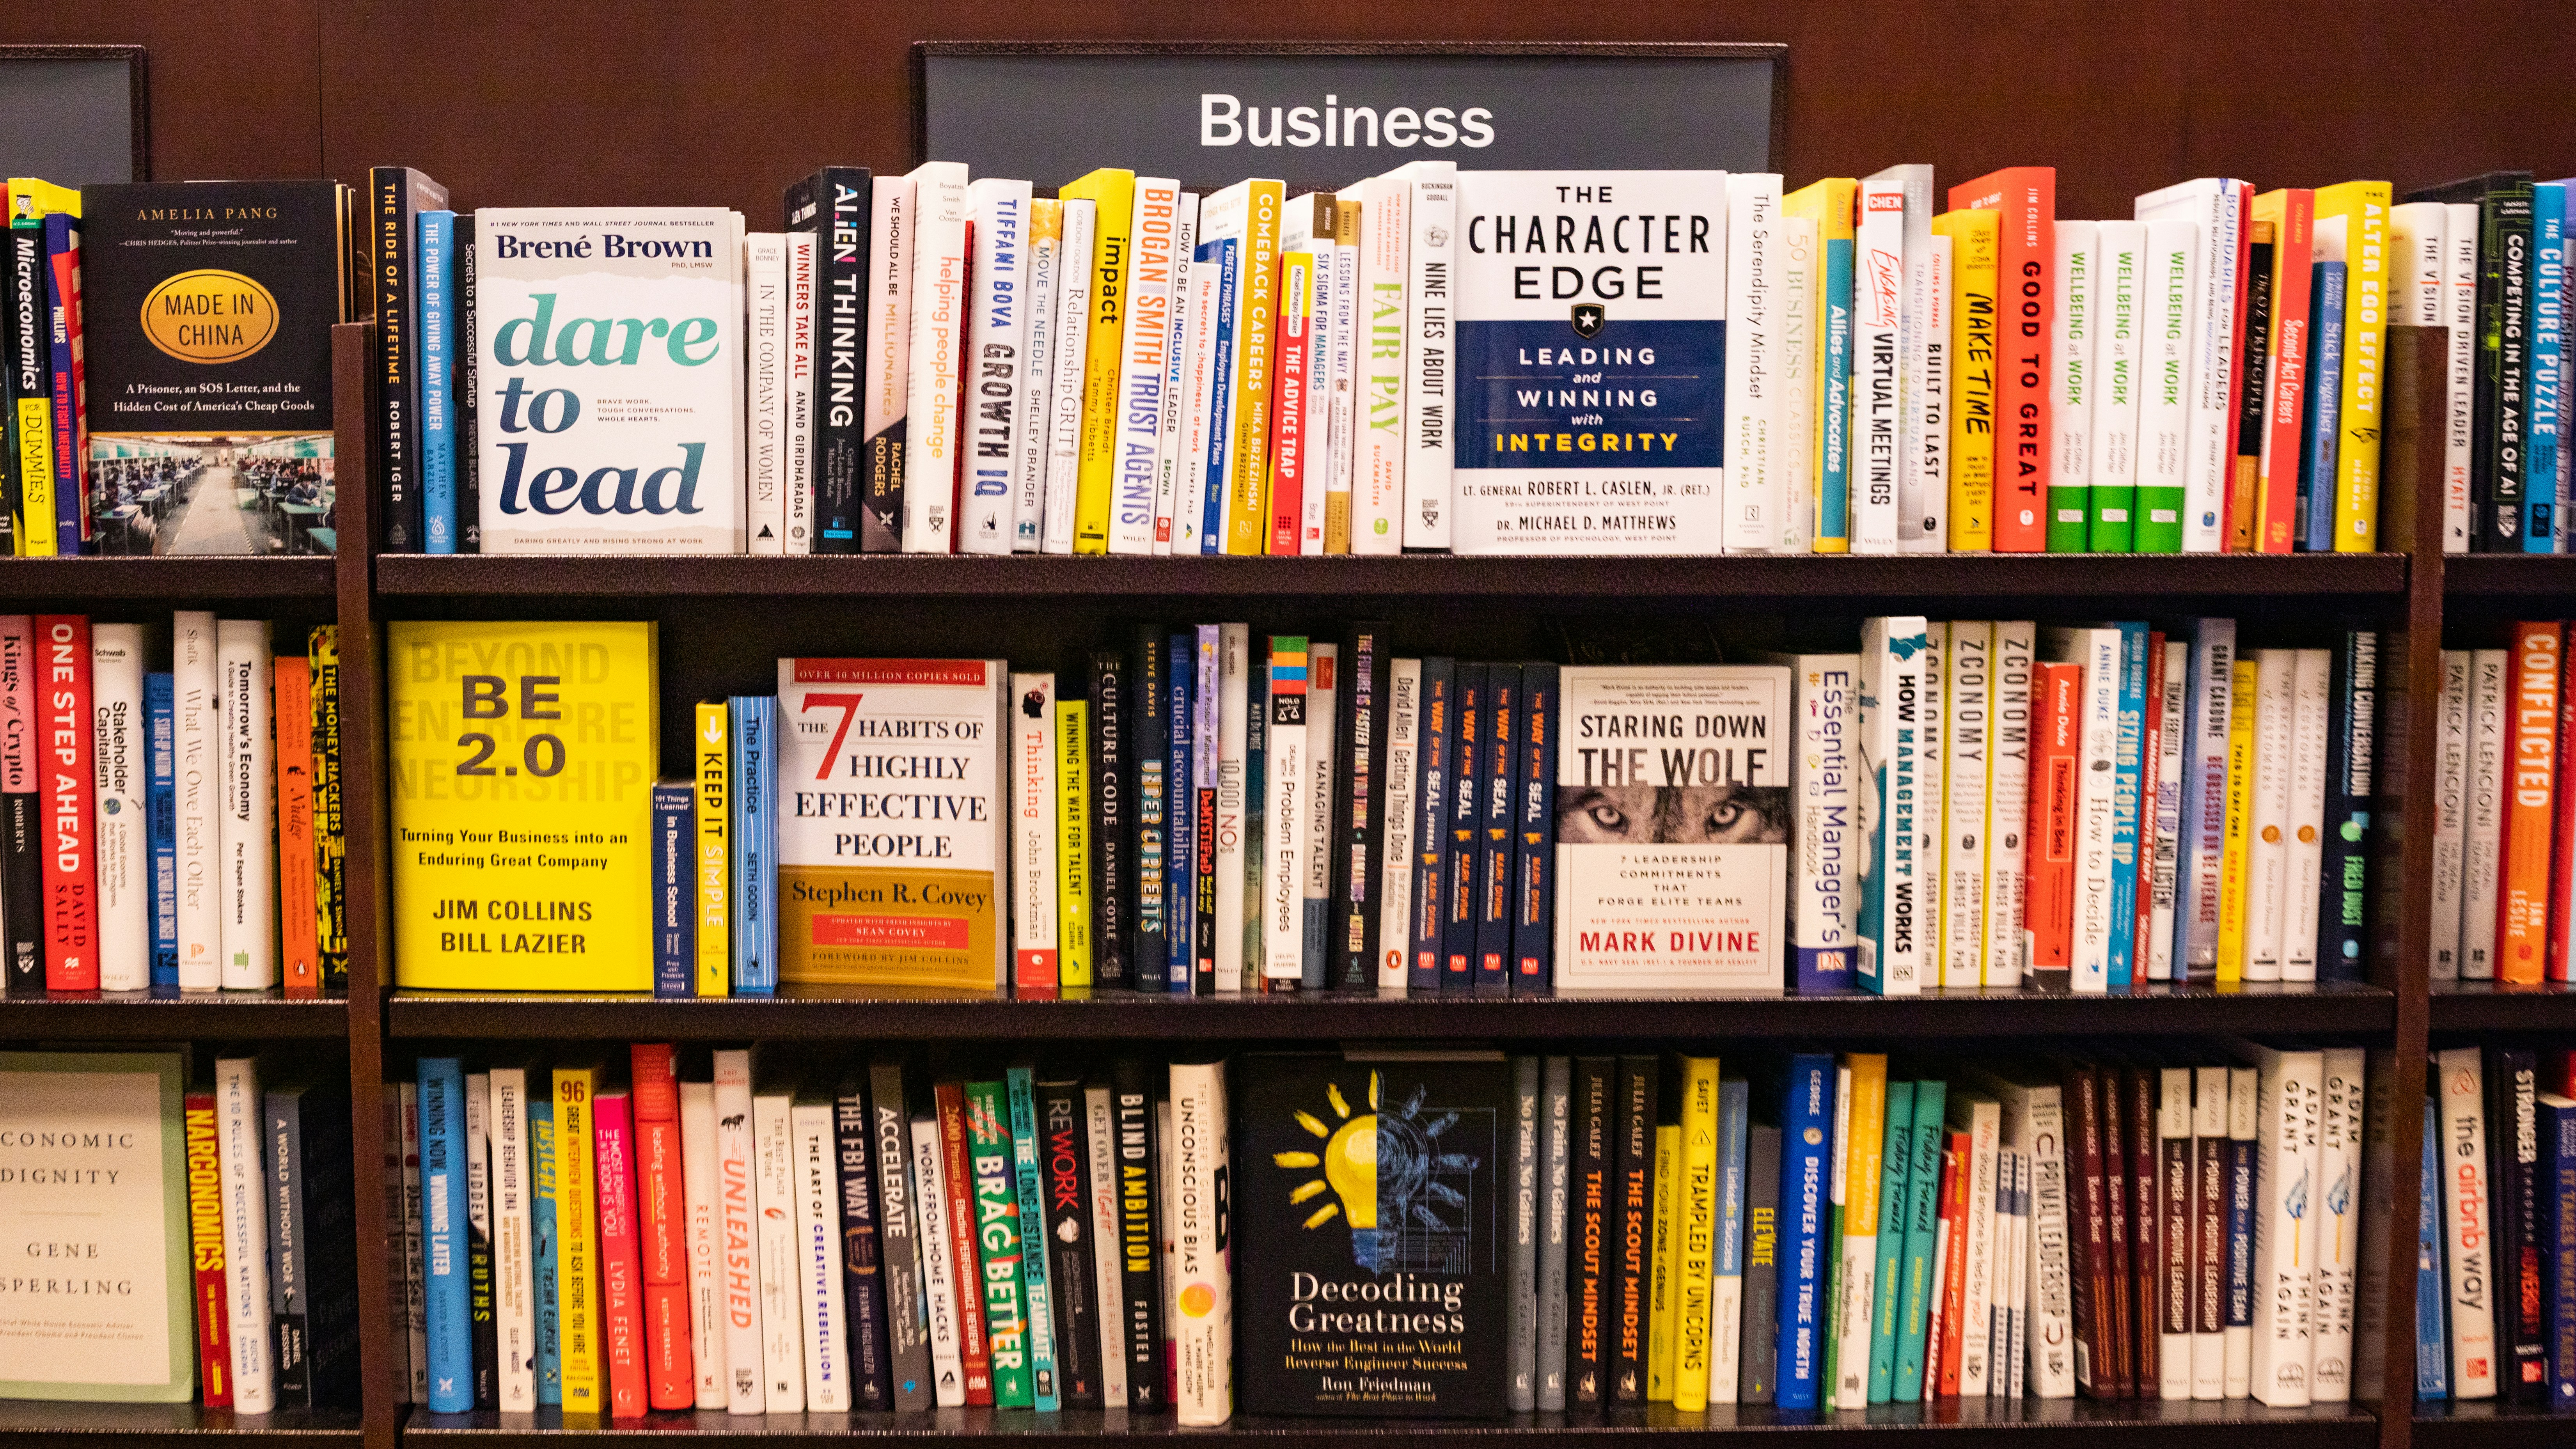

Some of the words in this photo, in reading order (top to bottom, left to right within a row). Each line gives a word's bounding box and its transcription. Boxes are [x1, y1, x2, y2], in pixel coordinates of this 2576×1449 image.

[1201, 93, 1495, 148] Business
[137, 208, 215, 220] AMELIA
[226, 208, 278, 219] PANG
[385, 183, 396, 214] THE
[1556, 187, 1613, 203] THE
[385, 222, 396, 259] RIDE
[498, 235, 592, 259] Brené
[603, 235, 712, 259] Brown
[994, 200, 1017, 271] TIFFANI
[1141, 189, 1174, 281] BROGAN
[1251, 194, 1272, 301] COMEBACK
[1469, 216, 1710, 254] CHARACTER
[2362, 203, 2381, 272] ALTER
[386, 265, 397, 286] OF
[387, 293, 396, 303] A
[796, 244, 809, 310] WINNERS
[933, 257, 961, 323] helping
[1100, 237, 1127, 325] impact
[1424, 262, 1447, 298] NINE
[1515, 266, 1663, 299] EDGE
[2022, 261, 2041, 339] GOOD
[16, 238, 40, 391] Microeconomics
[165, 294, 223, 316] MADE
[234, 294, 253, 314] IN
[991, 277, 1013, 328] BOVA
[1424, 308, 1445, 339] LIES
[2361, 281, 2379, 324] EGO
[179, 324, 243, 346] CHINA
[387, 309, 399, 383] LIFETIME
[494, 293, 720, 367] dare
[795, 316, 808, 349] TAKE
[830, 273, 858, 428] THINKING
[1133, 296, 1165, 365] SMITH
[1248, 307, 1267, 391] CAREERS
[795, 354, 807, 379] ALL
[935, 326, 955, 390] people
[1285, 345, 1301, 374] THE
[1422, 348, 1445, 397] ABOUT
[1520, 349, 1655, 365] LEADING
[1573, 372, 1602, 383] and
[1873, 333, 1894, 415] VIRTUAL
[2022, 355, 2040, 388] TO
[2357, 332, 2377, 412] EFFECT
[25, 404, 41, 412] FOR
[114, 401, 151, 412] Hidden
[154, 402, 177, 411] Cost
[180, 401, 191, 411] of
[193, 401, 242, 411] America's
[245, 401, 278, 413] Cheap
[281, 401, 314, 411] Goods
[126, 385, 135, 393] A
[137, 383, 182, 394] Prisoner,
[199, 383, 223, 393] SOS
[226, 383, 260, 394] Letter,
[263, 383, 281, 393] and
[284, 383, 300, 393] the
[495, 378, 580, 433] to
[976, 343, 1016, 458] GROWTH
[1127, 374, 1160, 435] TRUST
[1282, 378, 1299, 434] ADVICE
[1517, 390, 1657, 406] WINNING
[390, 401, 400, 459] ROBERT
[926, 393, 954, 459] change
[1421, 406, 1442, 449] WORK
[1497, 433, 1678, 451] INTEGRITY
[1572, 413, 1603, 426] with
[25, 415, 44, 504] DUMMIES
[1280, 438, 1297, 479] TRAP
[1870, 417, 1891, 505] MEETINGS
[2018, 403, 2038, 495] GREAT
[392, 467, 401, 501] IGER
[497, 442, 706, 515] lead
[974, 469, 1008, 496] IQ
[1121, 443, 1153, 525] AGENTS
[1464, 486, 1476, 496] LT.
[1480, 485, 1522, 496] GENERAL
[1528, 481, 1581, 496] ROBERT
[1586, 481, 1597, 495] L.
[1602, 481, 1656, 497] CASLEN,
[1680, 484, 1710, 496] (RET.)
[51, 624, 74, 683] ONE
[462, 675, 561, 719] BE
[1102, 673, 1116, 763] CULTURE
[1899, 675, 1915, 722] HOW
[2518, 633, 2556, 807] CONFLICTED
[54, 691, 76, 766] STEP
[98, 707, 110, 788] Capitalism
[113, 701, 128, 795] Stakeholder
[798, 722, 828, 733] THE
[801, 693, 863, 779] 7
[860, 720, 949, 737] HABITS
[955, 722, 983, 740] OF
[1580, 716, 1683, 739] STARING
[1696, 716, 1766, 739] DOWN
[1824, 670, 1848, 796] Essential
[456, 733, 566, 777] 2.0
[850, 756, 970, 779] HIGHLY
[1024, 731, 1042, 820] Thinking
[1579, 748, 1647, 787] THE
[1661, 748, 1767, 787] WOLF
[704, 753, 722, 808] KEEP
[1103, 772, 1117, 826] CODE
[1896, 729, 1914, 876] MANAGEMENT
[56, 774, 79, 873] AHEAD
[705, 818, 723, 837] IT
[795, 793, 987, 821] EFFECTIVE
[401, 828, 453, 844] Turning
[459, 830, 493, 843] Your
[499, 830, 568, 844] Business
[575, 831, 603, 844] into
[610, 834, 627, 844] an
[835, 834, 952, 858] PEOPLE
[419, 853, 484, 869] Enduring
[490, 855, 532, 867] Great
[538, 855, 607, 870] Company
[704, 845, 724, 928] SIMPLE
[1816, 805, 1847, 942] Manager's
[433, 900, 477, 920] JIM
[488, 901, 593, 921] COLLINS
[793, 881, 887, 907] Stephen
[893, 884, 917, 903] R.
[923, 885, 986, 912] Covey
[1895, 882, 1912, 953] WORKS
[441, 933, 491, 952] BILL
[502, 933, 585, 954] LAZIER
[1580, 932, 1655, 952] MARK
[1670, 932, 1759, 952] DIVINE
[1121, 1094, 1145, 1159] BLIND
[2456, 1115, 2477, 1157] the
[879, 1107, 906, 1238] ACCELERATE
[1049, 1099, 1079, 1210] REWORK
[1181, 1098, 1198, 1229] UNCONSCIOUS
[186, 1110, 223, 1272] NARCONOMICS
[976, 1155, 1011, 1252] BRAG
[1586, 1171, 1601, 1208] THE
[2458, 1164, 2484, 1249] airbnb
[1124, 1165, 1150, 1272] AMBITION
[27, 1243, 98, 1258] GENE
[724, 1160, 751, 1328] UNLEASHED
[1184, 1234, 1198, 1274] BIAS
[1584, 1213, 1602, 1275] SCOUT
[610, 1262, 625, 1307] LYDIA
[1290, 1272, 1464, 1312] Decoding
[2458, 1253, 2482, 1311] way
[986, 1261, 1022, 1370] BETTER
[1290, 1303, 1464, 1334] Greatness
[1582, 1279, 1598, 1362] MINDSET
[615, 1316, 630, 1366] FENET
[1322, 1376, 1353, 1392] Ron
[1359, 1377, 1431, 1392] Friedman
